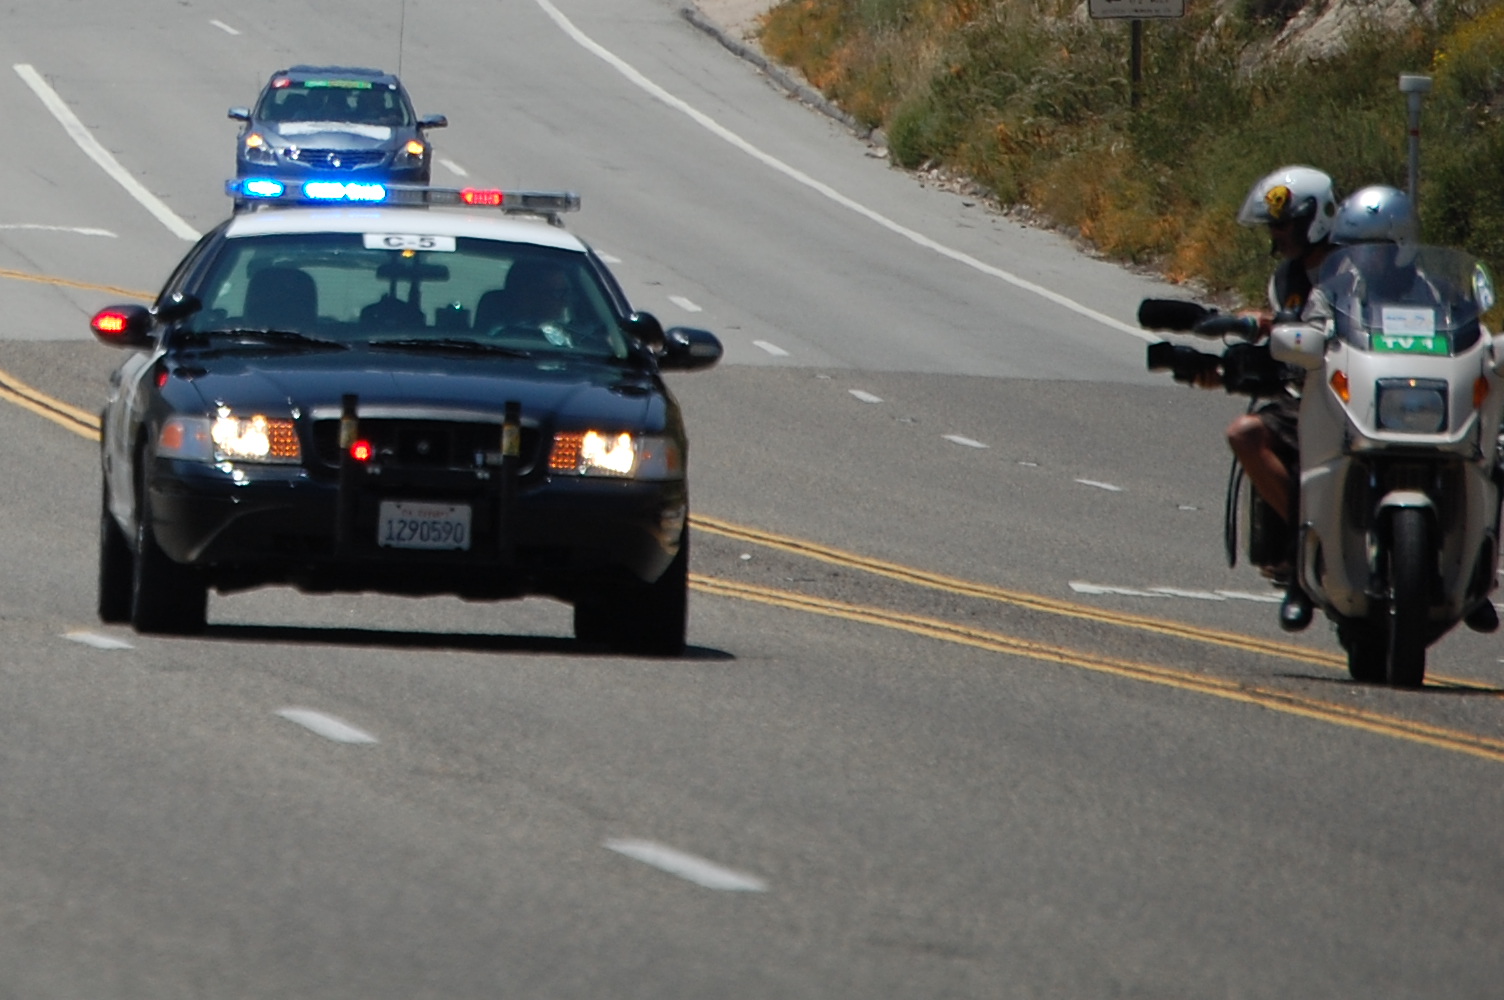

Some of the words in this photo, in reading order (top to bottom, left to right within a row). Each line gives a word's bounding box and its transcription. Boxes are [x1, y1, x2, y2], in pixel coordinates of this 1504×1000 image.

[383, 236, 437, 248] C-5
[1382, 337, 1414, 349] TV
[385, 519, 465, 544] 1290590
